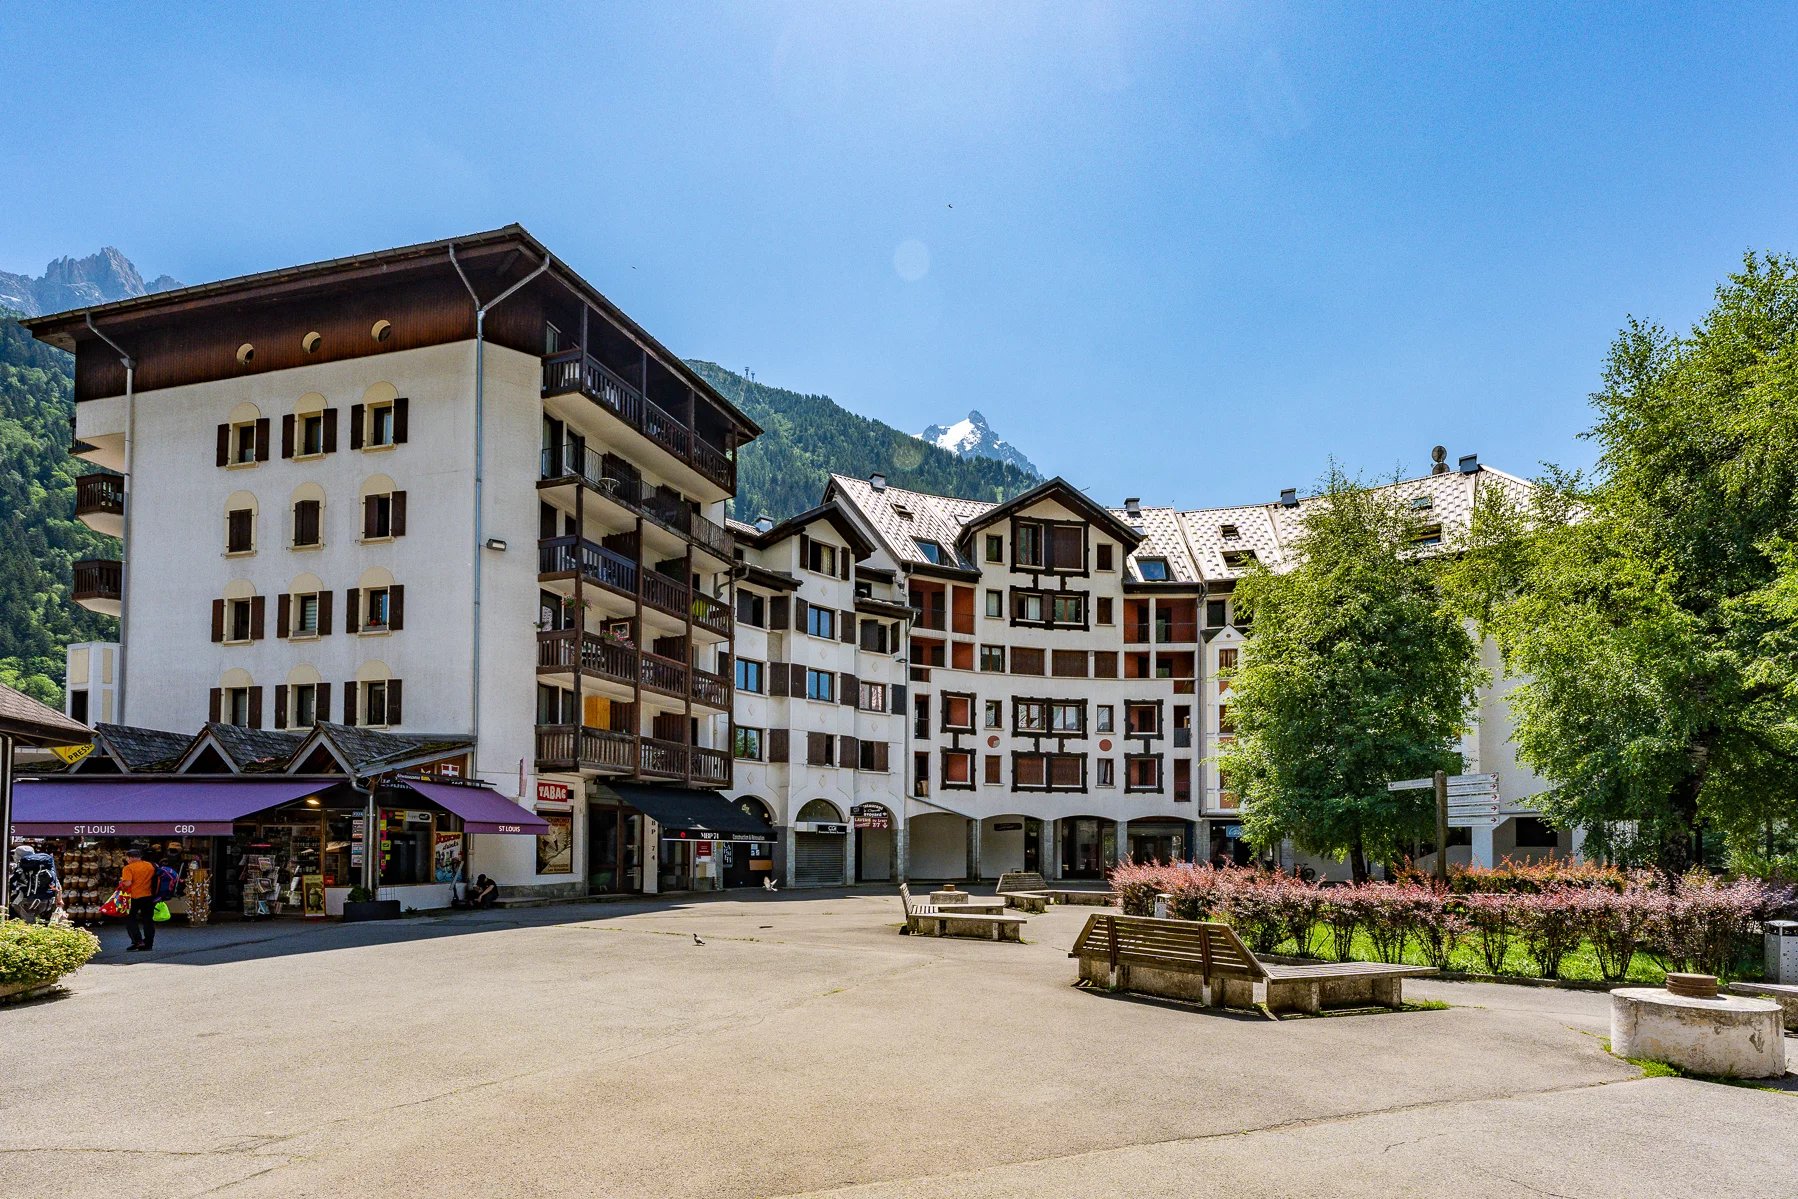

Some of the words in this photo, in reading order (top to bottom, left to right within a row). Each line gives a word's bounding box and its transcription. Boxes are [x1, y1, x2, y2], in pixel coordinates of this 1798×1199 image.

[67, 744, 93, 761] PRESS
[538, 785, 567, 800] TABAC
[74, 825, 85, 834] ST
[87, 825, 116, 834] LOUIS
[174, 825, 195, 833] CBD
[498, 825, 506, 833] ST
